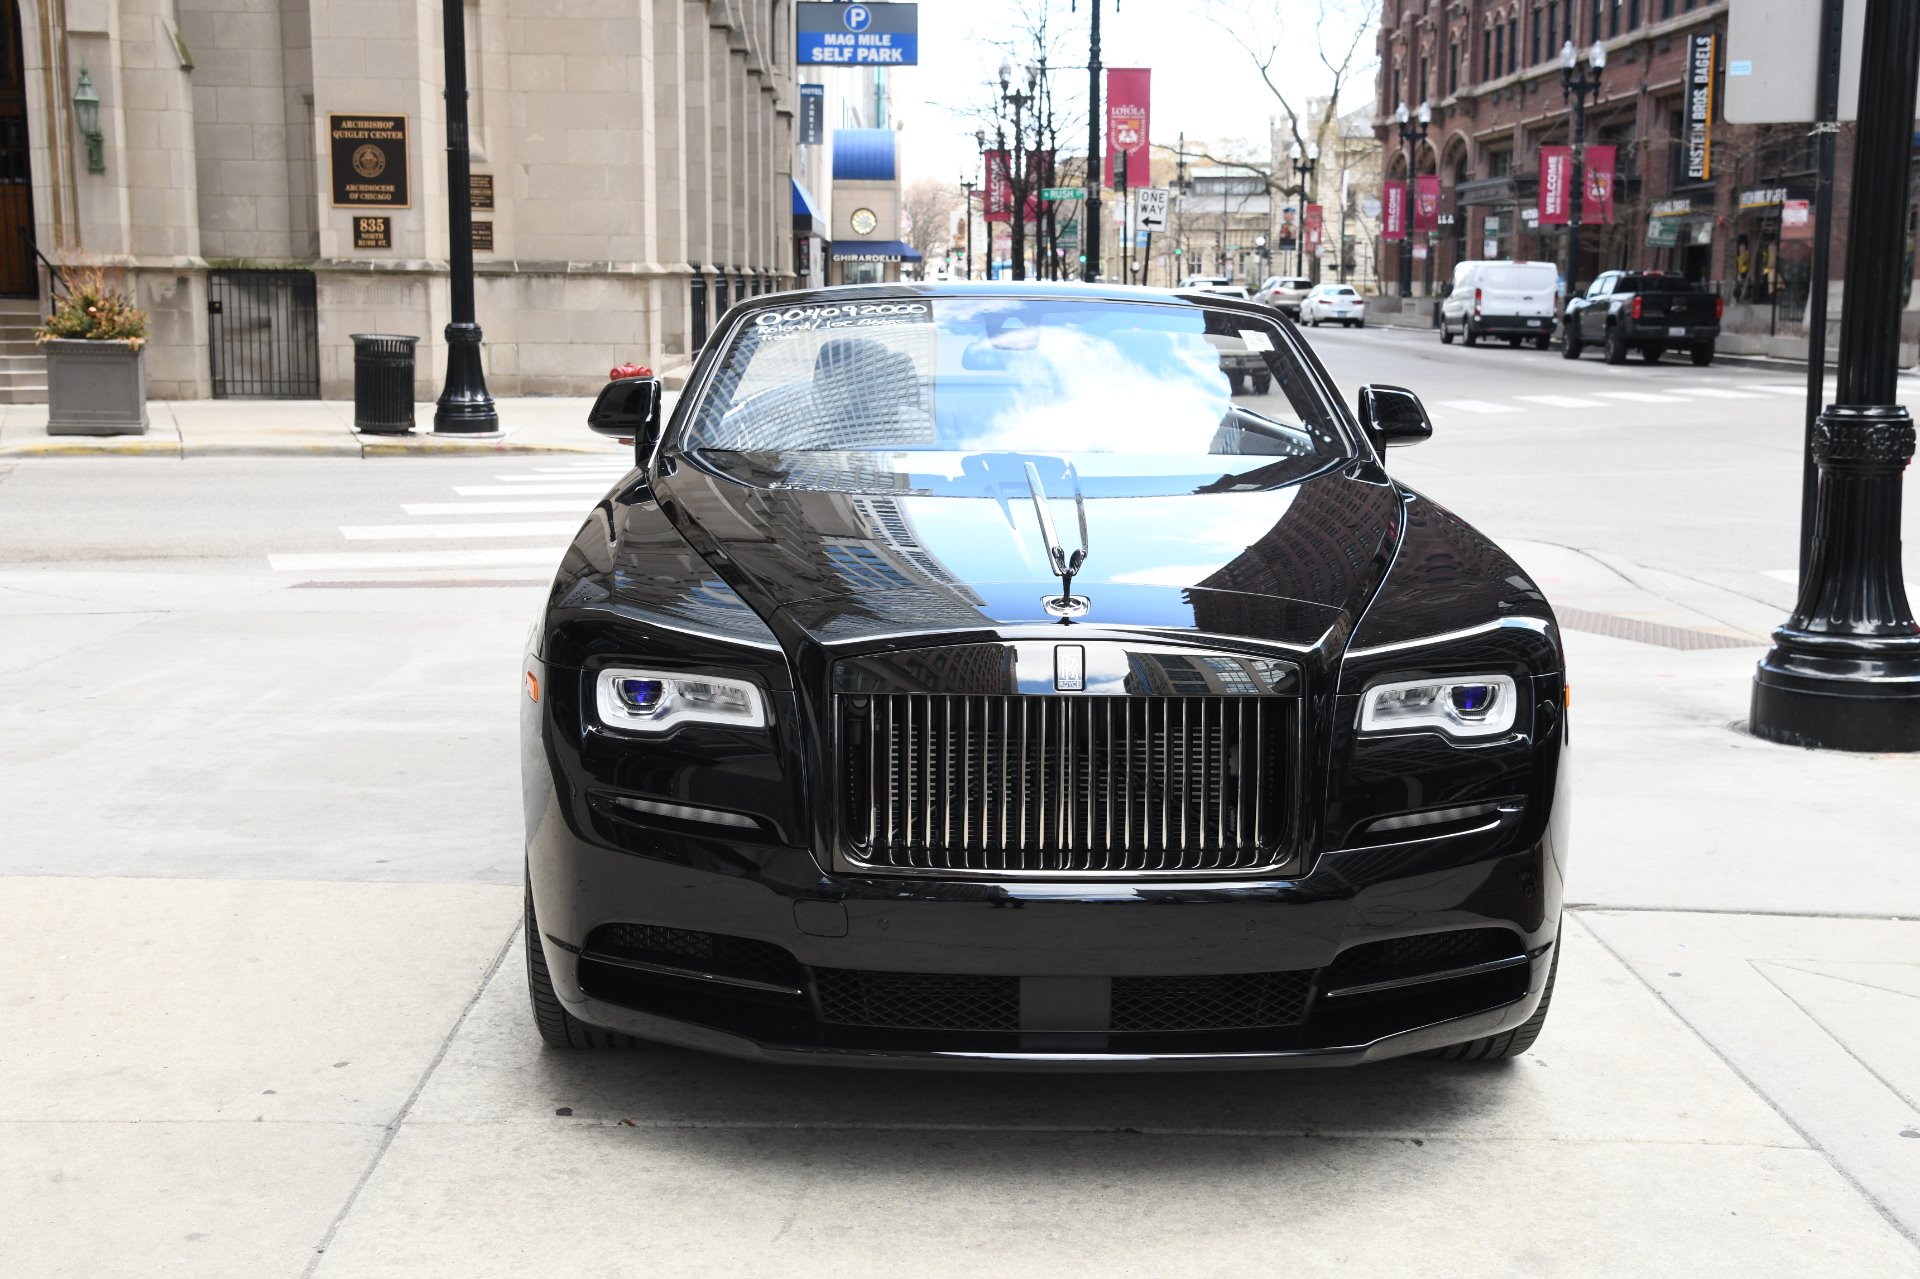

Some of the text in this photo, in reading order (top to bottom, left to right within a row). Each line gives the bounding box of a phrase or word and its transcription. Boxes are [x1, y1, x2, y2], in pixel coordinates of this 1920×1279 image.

[850, 8, 866, 28] P
[824, 33, 892, 46] MAG MILE
[812, 47, 903, 62] SELF PARK
[1111, 106, 1146, 115] LOYOLA
[1688, 36, 1711, 178] EINSTEIN BROS. BAGELS
[341, 120, 395, 129] ARCHBISHOP
[333, 130, 404, 140] QUIGLEY CENTER
[345, 184, 395, 192] ARCHDIOCESE
[1545, 155, 1557, 215] WELCOME
[1050, 189, 1074, 200] RUSH
[1142, 191, 1165, 203] ONE
[1140, 204, 1165, 215] WAY
[1387, 188, 1396, 233] WELCOME
[360, 218, 385, 232] 835
[832, 254, 901, 262] GHIRARDELLI
